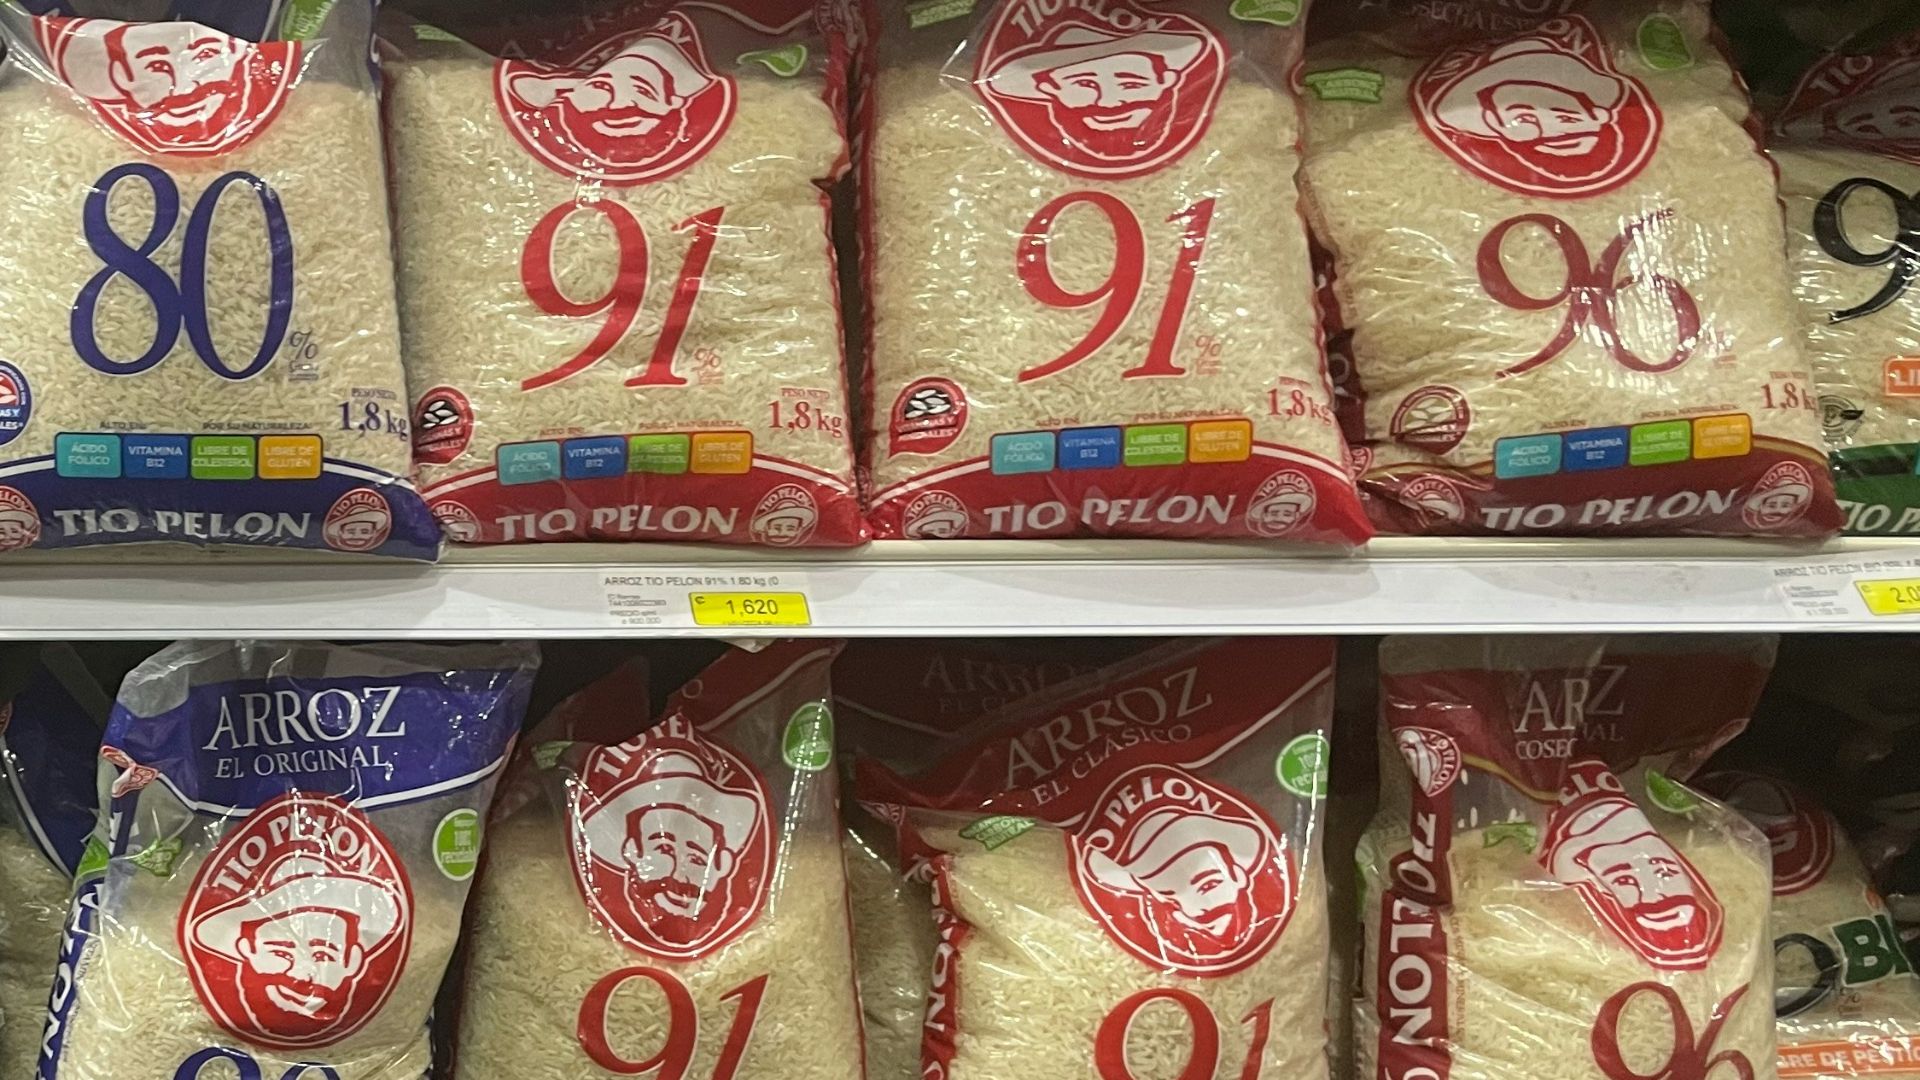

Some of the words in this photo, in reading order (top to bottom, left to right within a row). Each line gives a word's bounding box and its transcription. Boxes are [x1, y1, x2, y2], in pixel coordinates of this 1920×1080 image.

[1266, 387, 1305, 421] 1,8
[385, 409, 408, 441] kg
[768, 400, 811, 435] 1,8
[815, 408, 843, 439] kg
[1063, 436, 1117, 448] VITAMINA
[1130, 433, 1162, 444] LIBRE
[1569, 437, 1623, 450] VITAMINA
[128, 445, 183, 457] VITAMINA
[198, 445, 230, 457] LIBRE
[231, 446, 247, 457] DE
[265, 446, 296, 457] LIBRE
[567, 446, 622, 458] VITAMINA
[1080, 448, 1098, 458] B12
[145, 457, 166, 469] B12
[191, 456, 253, 468] COLESTEROL
[267, 457, 312, 469] GLUTEN
[585, 458, 604, 469] B12
[984, 500, 1067, 533] TIO
[1081, 494, 1237, 526] PELON
[1480, 503, 1566, 531] TIO
[1579, 487, 1743, 526] PELON
[53, 508, 140, 537] TIO
[154, 509, 312, 539] PELON
[496, 508, 577, 541] TIO
[591, 505, 740, 534] PELON
[604, 577, 642, 586] ARROZ
[646, 577, 663, 586] TIO
[665, 577, 703, 586] PELON
[753, 577, 766, 587] kg
[726, 599, 778, 618] 1,620
[201, 685, 406, 750] ARROZ
[1006, 666, 1213, 790] ARROZ
[215, 758, 244, 779] EL
[253, 745, 390, 776] ORIGINAL
[1031, 782, 1070, 806] EL
[1104, 776, 1222, 828] PELON
[213, 835, 268, 894] TIO
[1831, 914, 1912, 987] BI
[1820, 1051, 1849, 1067] DE
